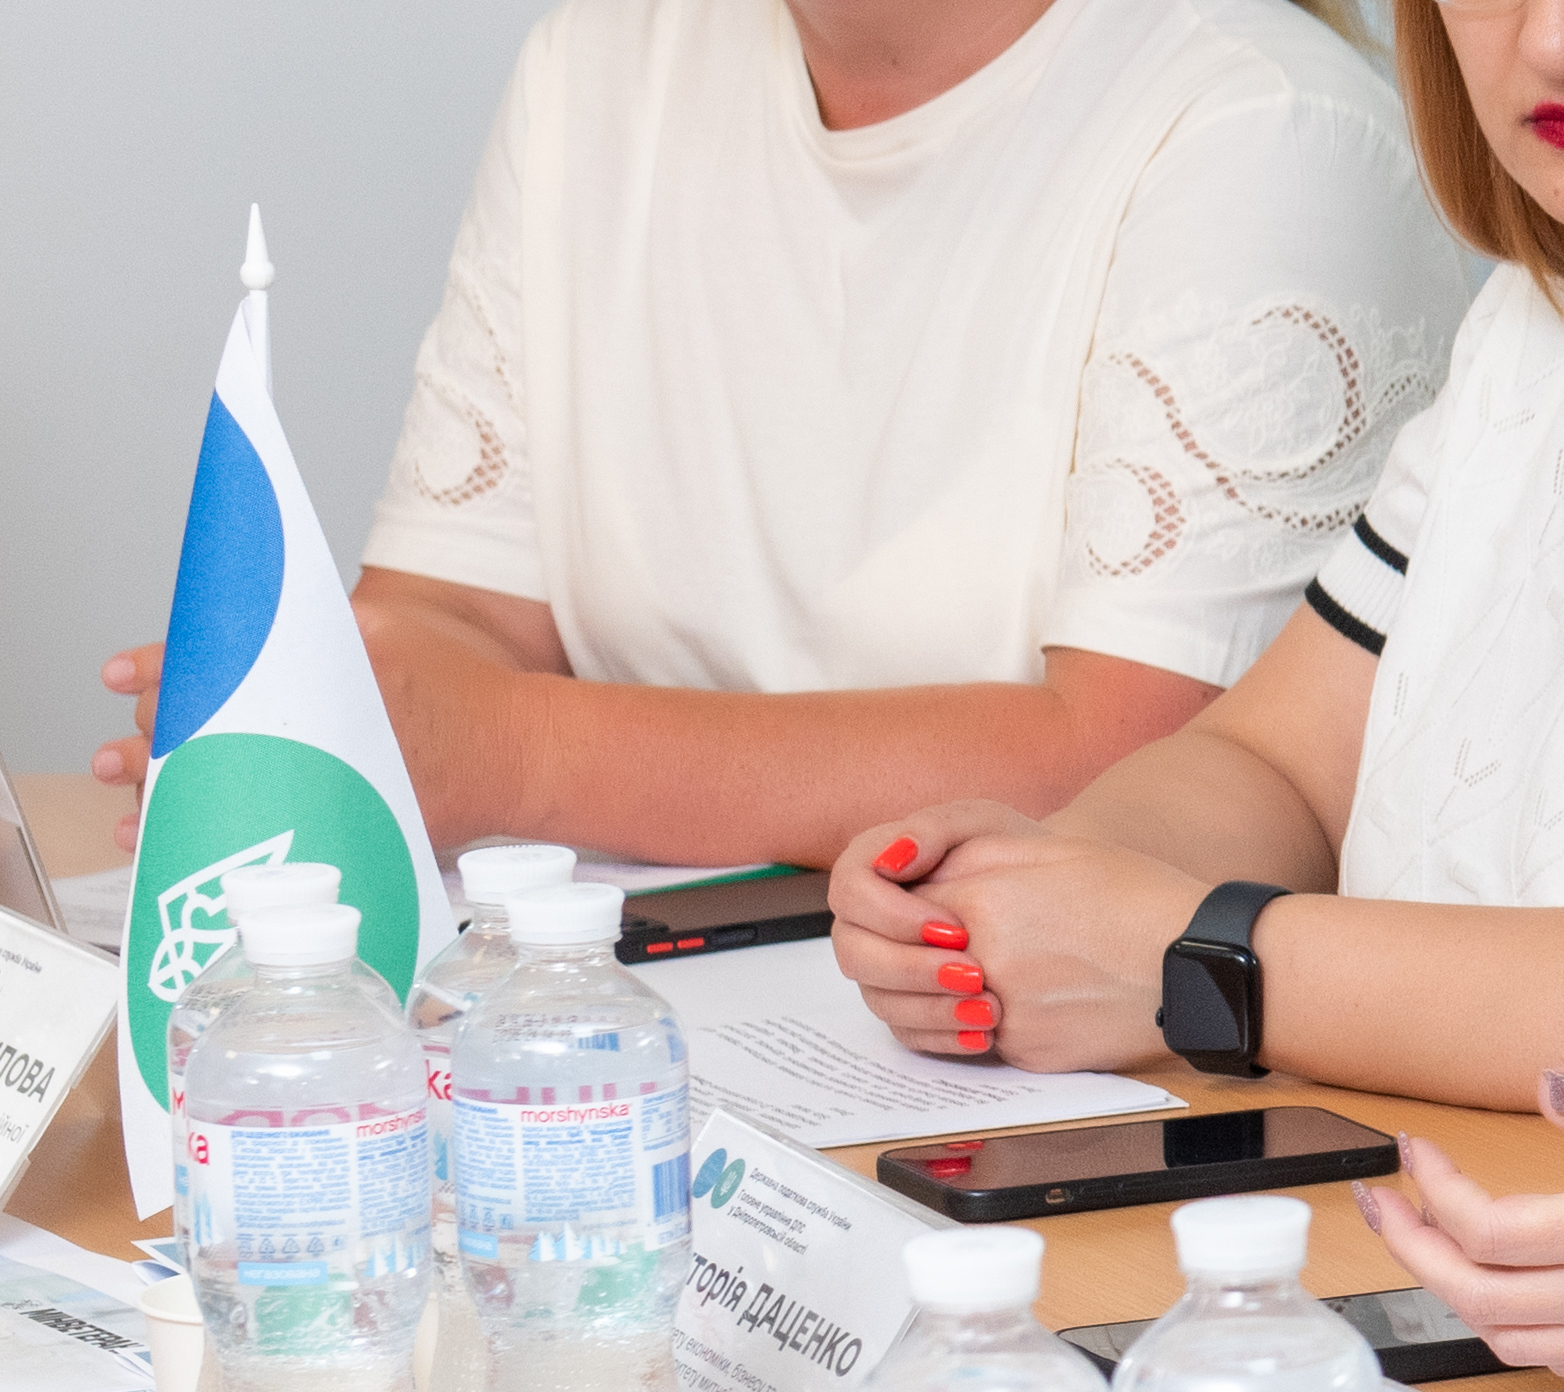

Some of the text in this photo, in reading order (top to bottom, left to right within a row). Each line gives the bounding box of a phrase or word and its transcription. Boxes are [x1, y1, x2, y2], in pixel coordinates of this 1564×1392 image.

[520, 1103, 631, 1125] morshynska
[686, 1252, 863, 1378] торія ДАЦЕНКО
